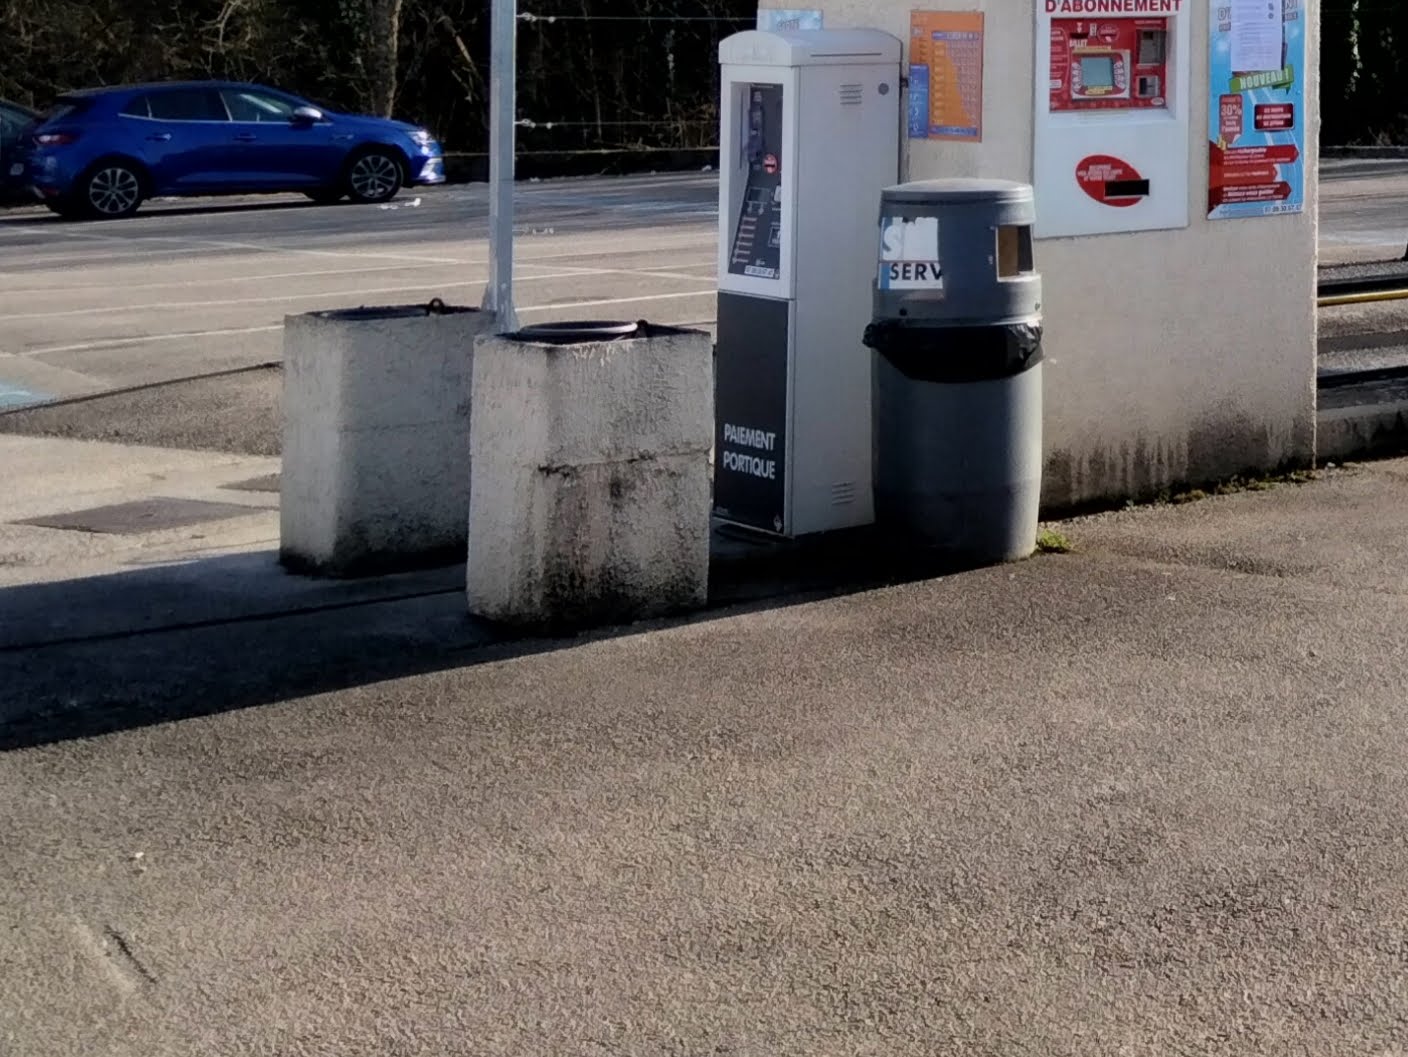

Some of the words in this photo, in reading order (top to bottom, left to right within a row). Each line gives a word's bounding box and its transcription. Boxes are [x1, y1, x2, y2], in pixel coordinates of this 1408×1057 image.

[1240, 70, 1283, 90] NOUVEAU
[1220, 104, 1242, 116] 30%
[890, 263, 943, 281] SERV
[724, 423, 776, 451] PAIEMENT
[723, 451, 776, 480] PORTIQUE
